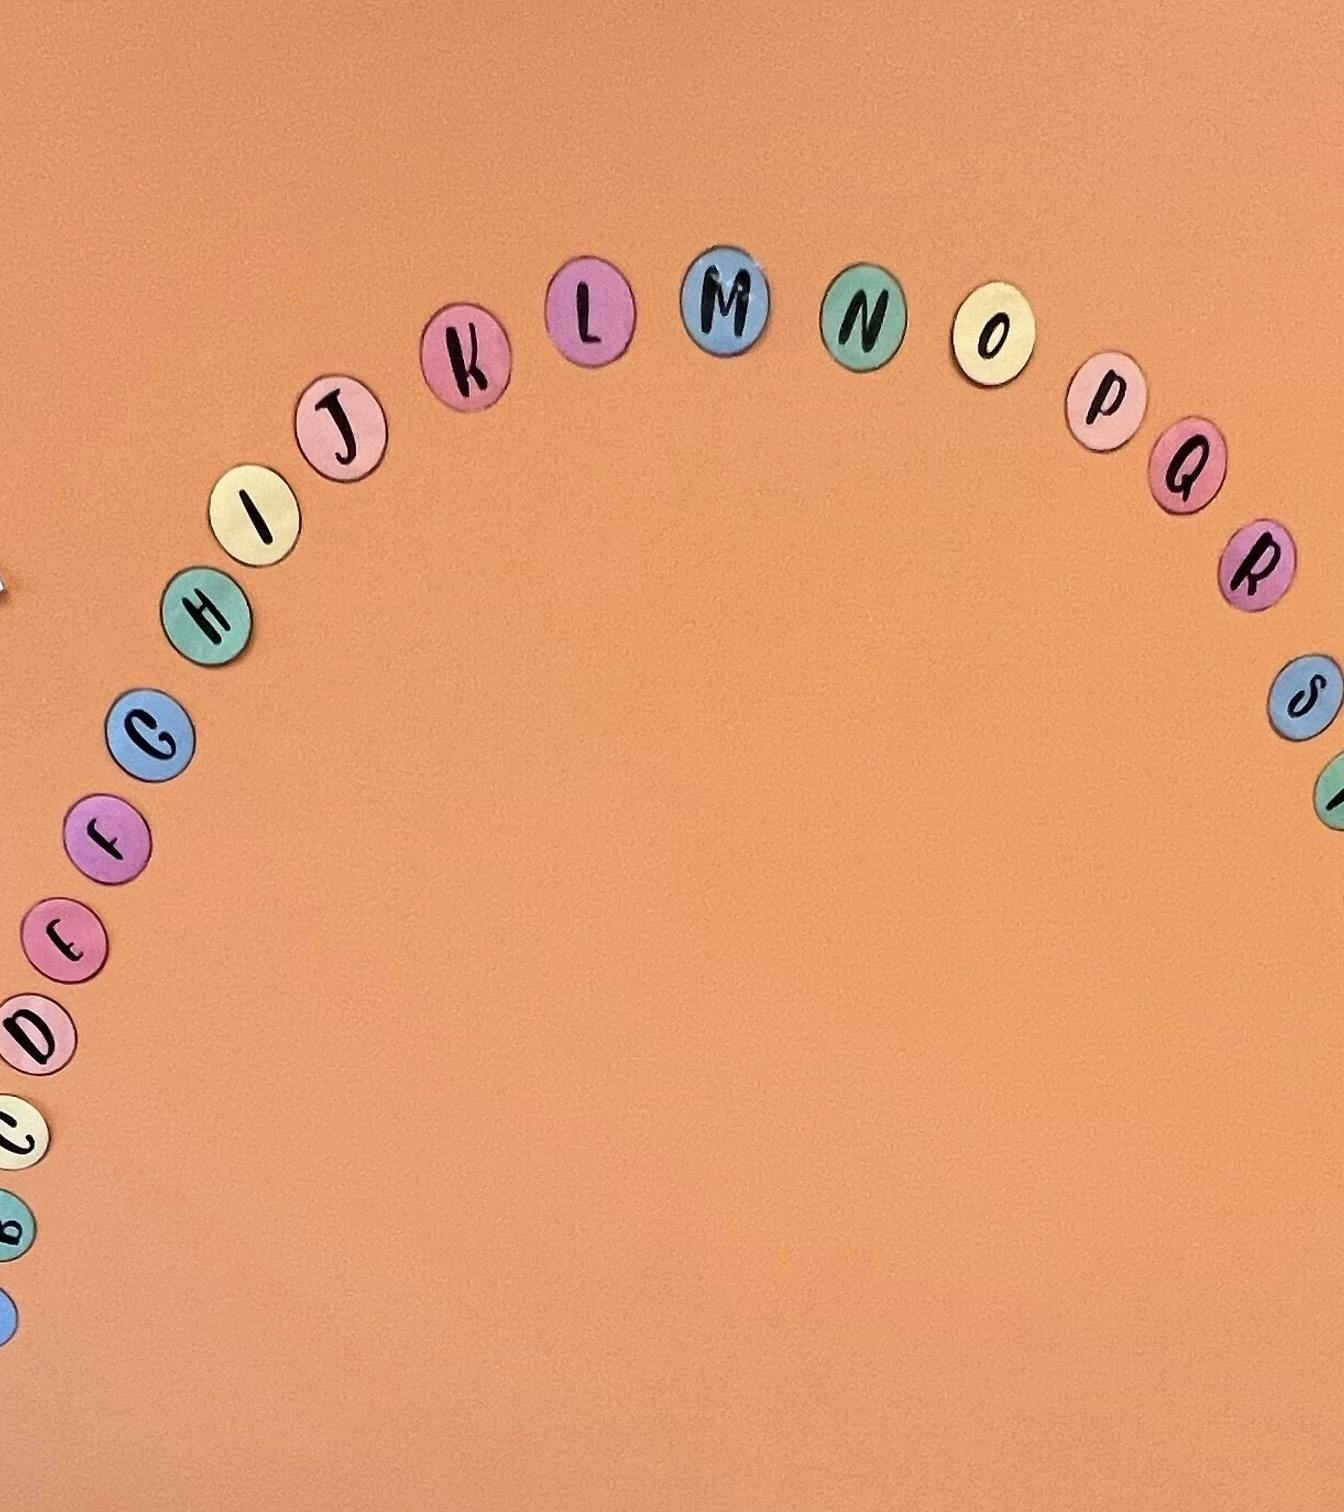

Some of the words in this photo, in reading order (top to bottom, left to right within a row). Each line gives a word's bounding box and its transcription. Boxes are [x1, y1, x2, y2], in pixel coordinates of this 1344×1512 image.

[2, 1008, 56, 1065] D
[45, 918, 84, 962] E
[86, 818, 124, 860] F
[181, 588, 231, 645] H
[238, 489, 273, 545] I
[314, 388, 357, 465] J
[445, 322, 488, 398] K
[576, 282, 601, 344] L
[700, 264, 752, 337] M
[838, 289, 890, 353] N
[977, 312, 1010, 360] O
[1085, 369, 1127, 425] P
[1165, 434, 1210, 502] Q
[1229, 531, 1281, 596] R
[1287, 674, 1327, 718] S
